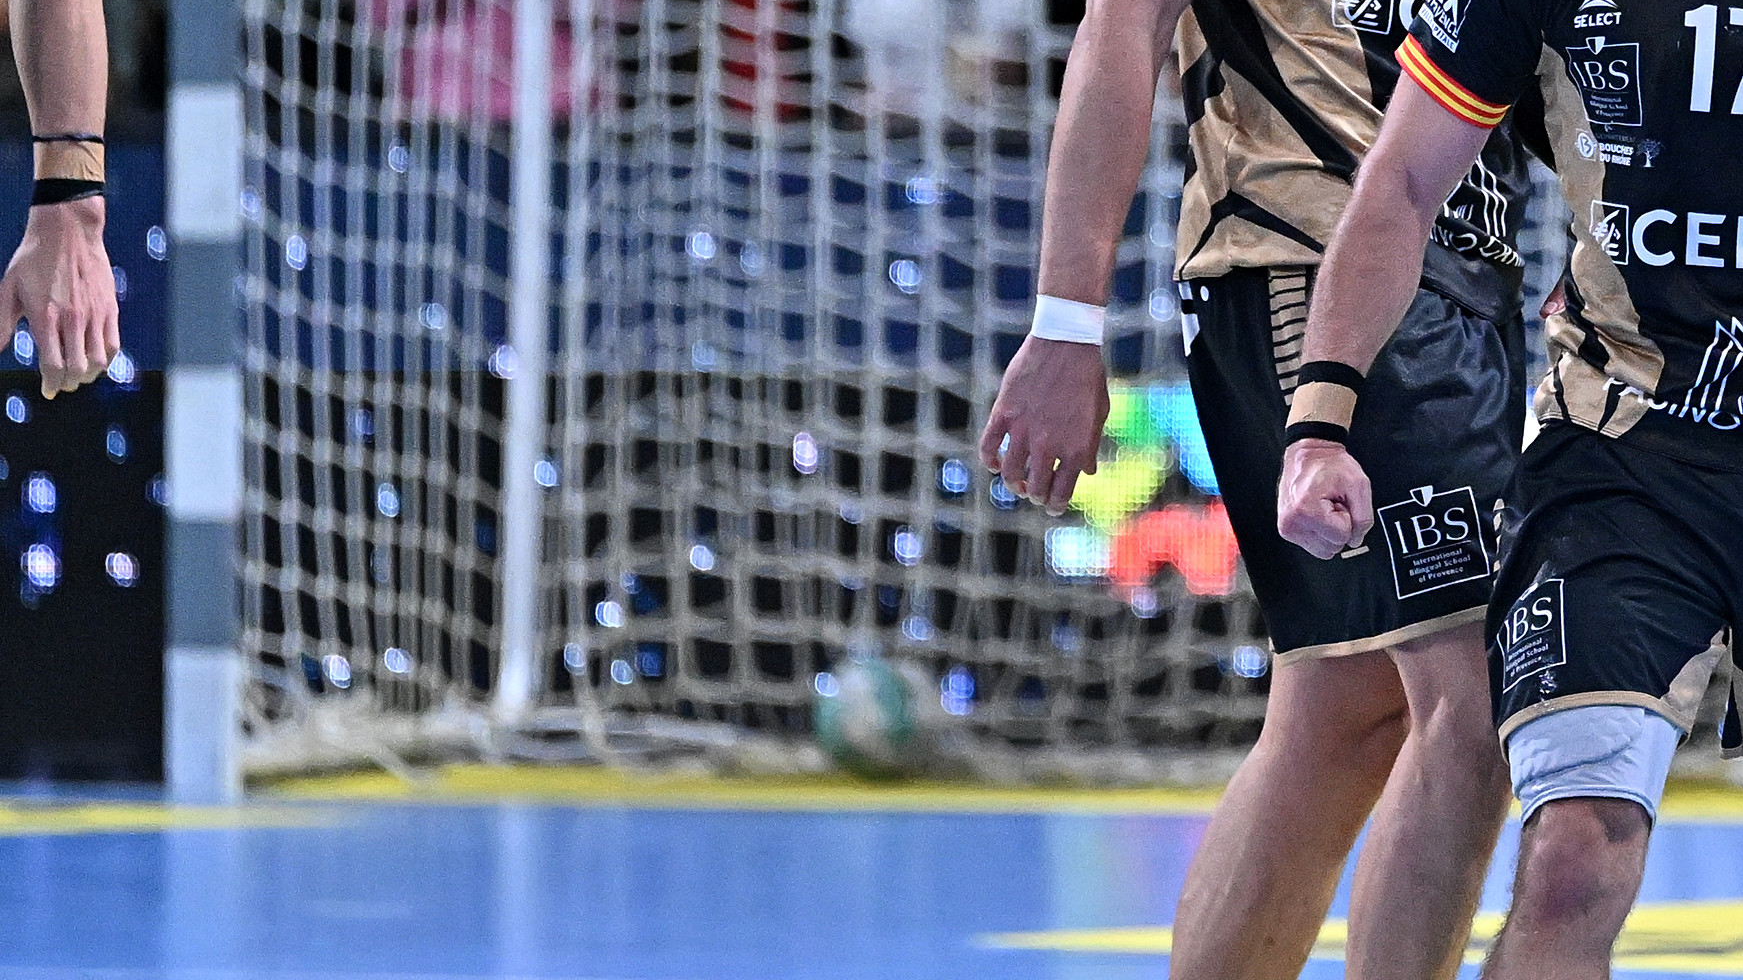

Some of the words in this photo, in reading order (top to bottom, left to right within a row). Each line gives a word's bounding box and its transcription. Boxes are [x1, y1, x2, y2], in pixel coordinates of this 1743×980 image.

[1573, 12, 1622, 28] SELECT
[1573, 59, 1630, 90] IBS
[1394, 507, 1470, 554] IBS
[1409, 560, 1442, 577] Bilingual
[1443, 554, 1471, 569] School
[1412, 547, 1463, 567] International
[1418, 574, 1427, 583] of
[1428, 566, 1464, 581] Provence
[1504, 597, 1554, 653] IBS
